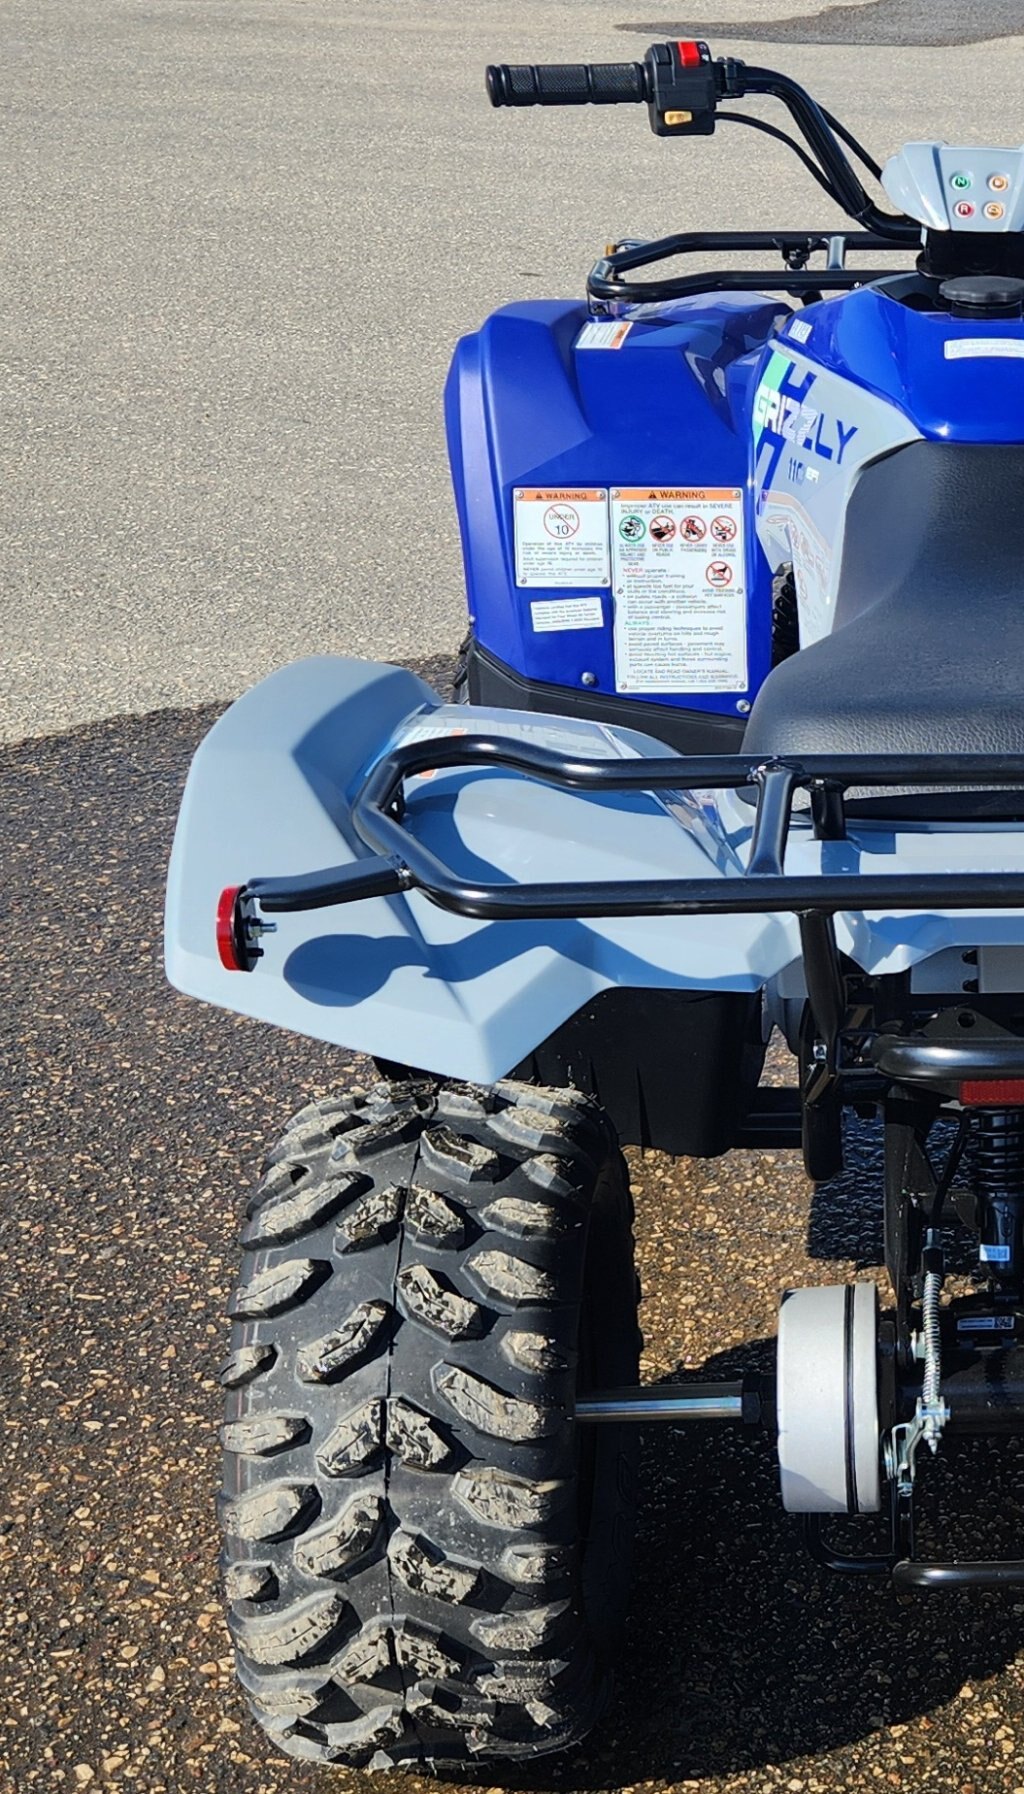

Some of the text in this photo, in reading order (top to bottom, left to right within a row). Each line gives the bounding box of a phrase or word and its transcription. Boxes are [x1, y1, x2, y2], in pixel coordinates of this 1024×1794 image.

[753, 383, 858, 465] GRIZZLY
[545, 492, 587, 500] WARNING
[660, 490, 706, 499] WARNING
[555, 524, 570, 535] 10
